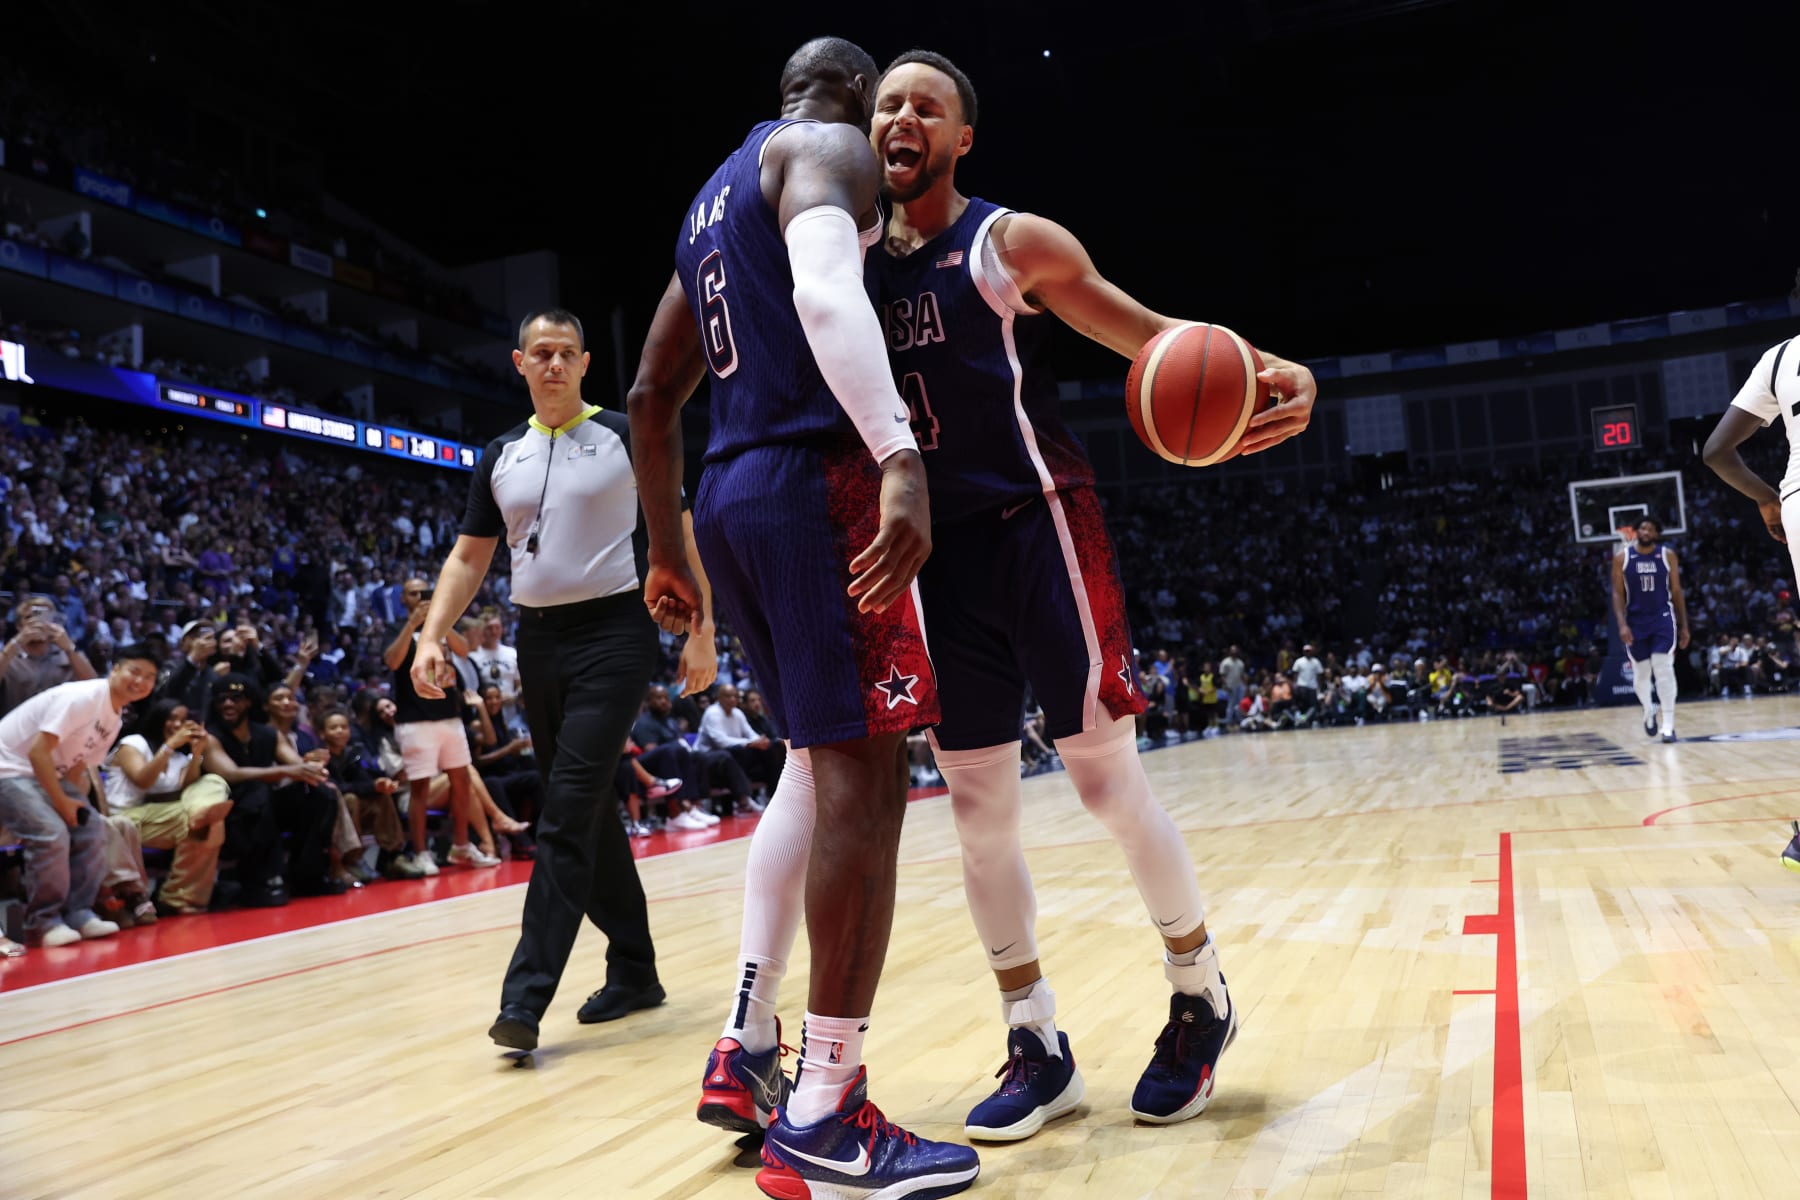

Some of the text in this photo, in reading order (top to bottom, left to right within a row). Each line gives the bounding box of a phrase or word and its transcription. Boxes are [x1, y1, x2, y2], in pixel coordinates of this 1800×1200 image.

[697, 249, 739, 379] 6
[901, 372, 941, 452] 4
[1603, 422, 1631, 446] 20
[1639, 575, 1655, 592] 11
